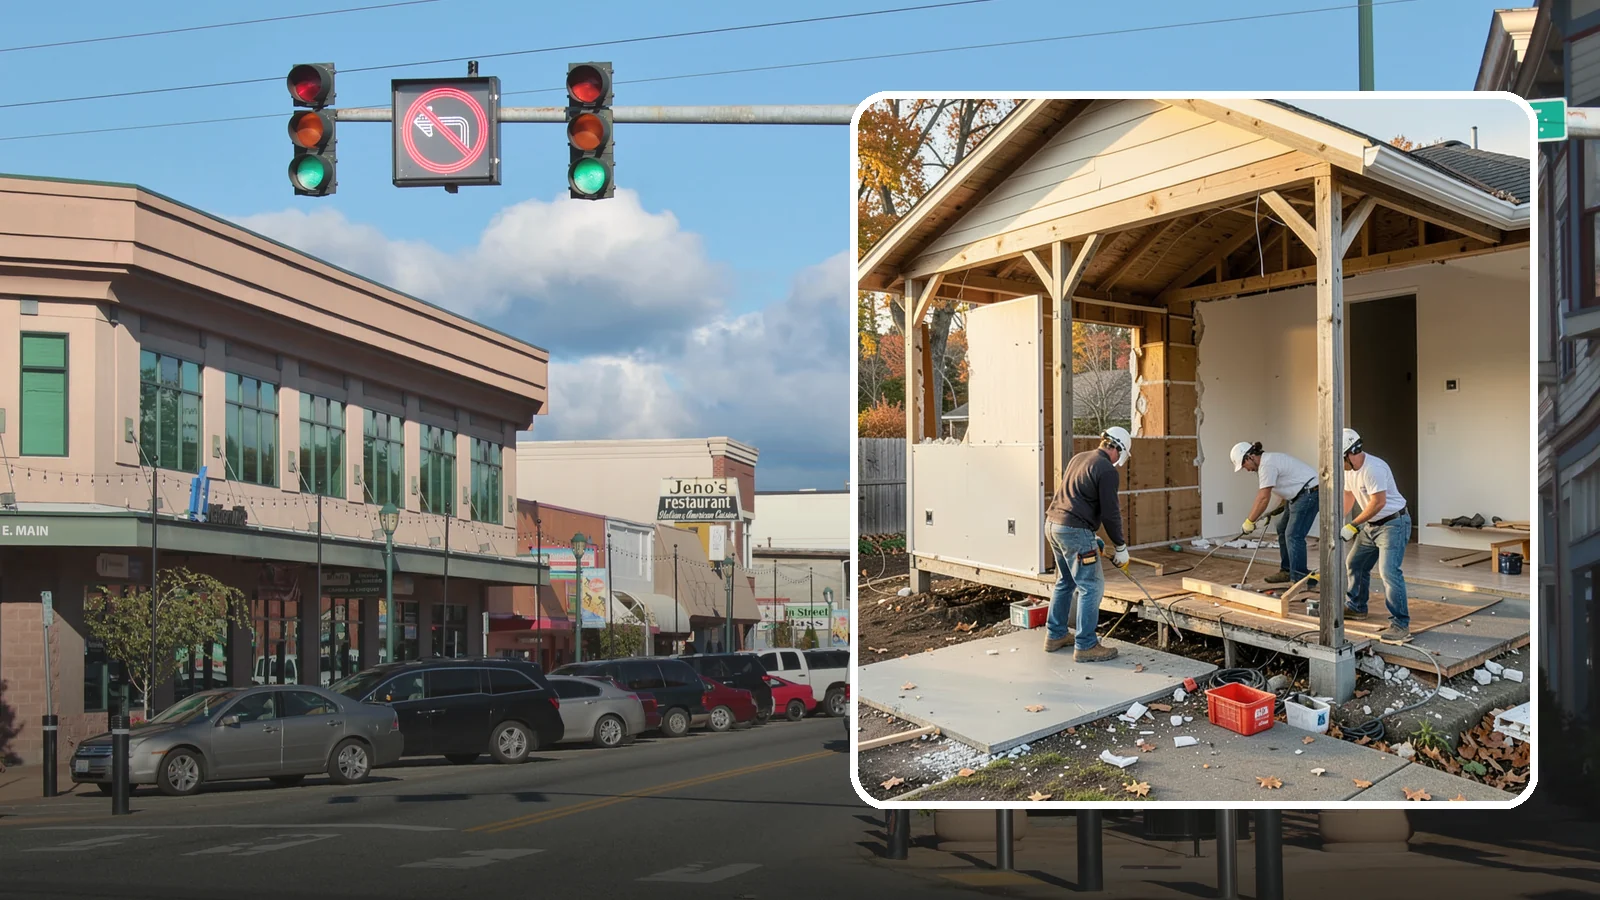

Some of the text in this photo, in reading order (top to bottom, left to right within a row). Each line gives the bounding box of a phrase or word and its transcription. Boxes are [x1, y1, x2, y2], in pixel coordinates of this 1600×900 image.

[670, 480, 727, 494] Jeno's
[665, 496, 731, 509] restaurant
[658, 510, 681, 520] Italian
[686, 510, 714, 520] American
[715, 510, 737, 520] Cuisine
[2, 525, 49, 536] E. MAIN
[797, 607, 828, 617] Street
